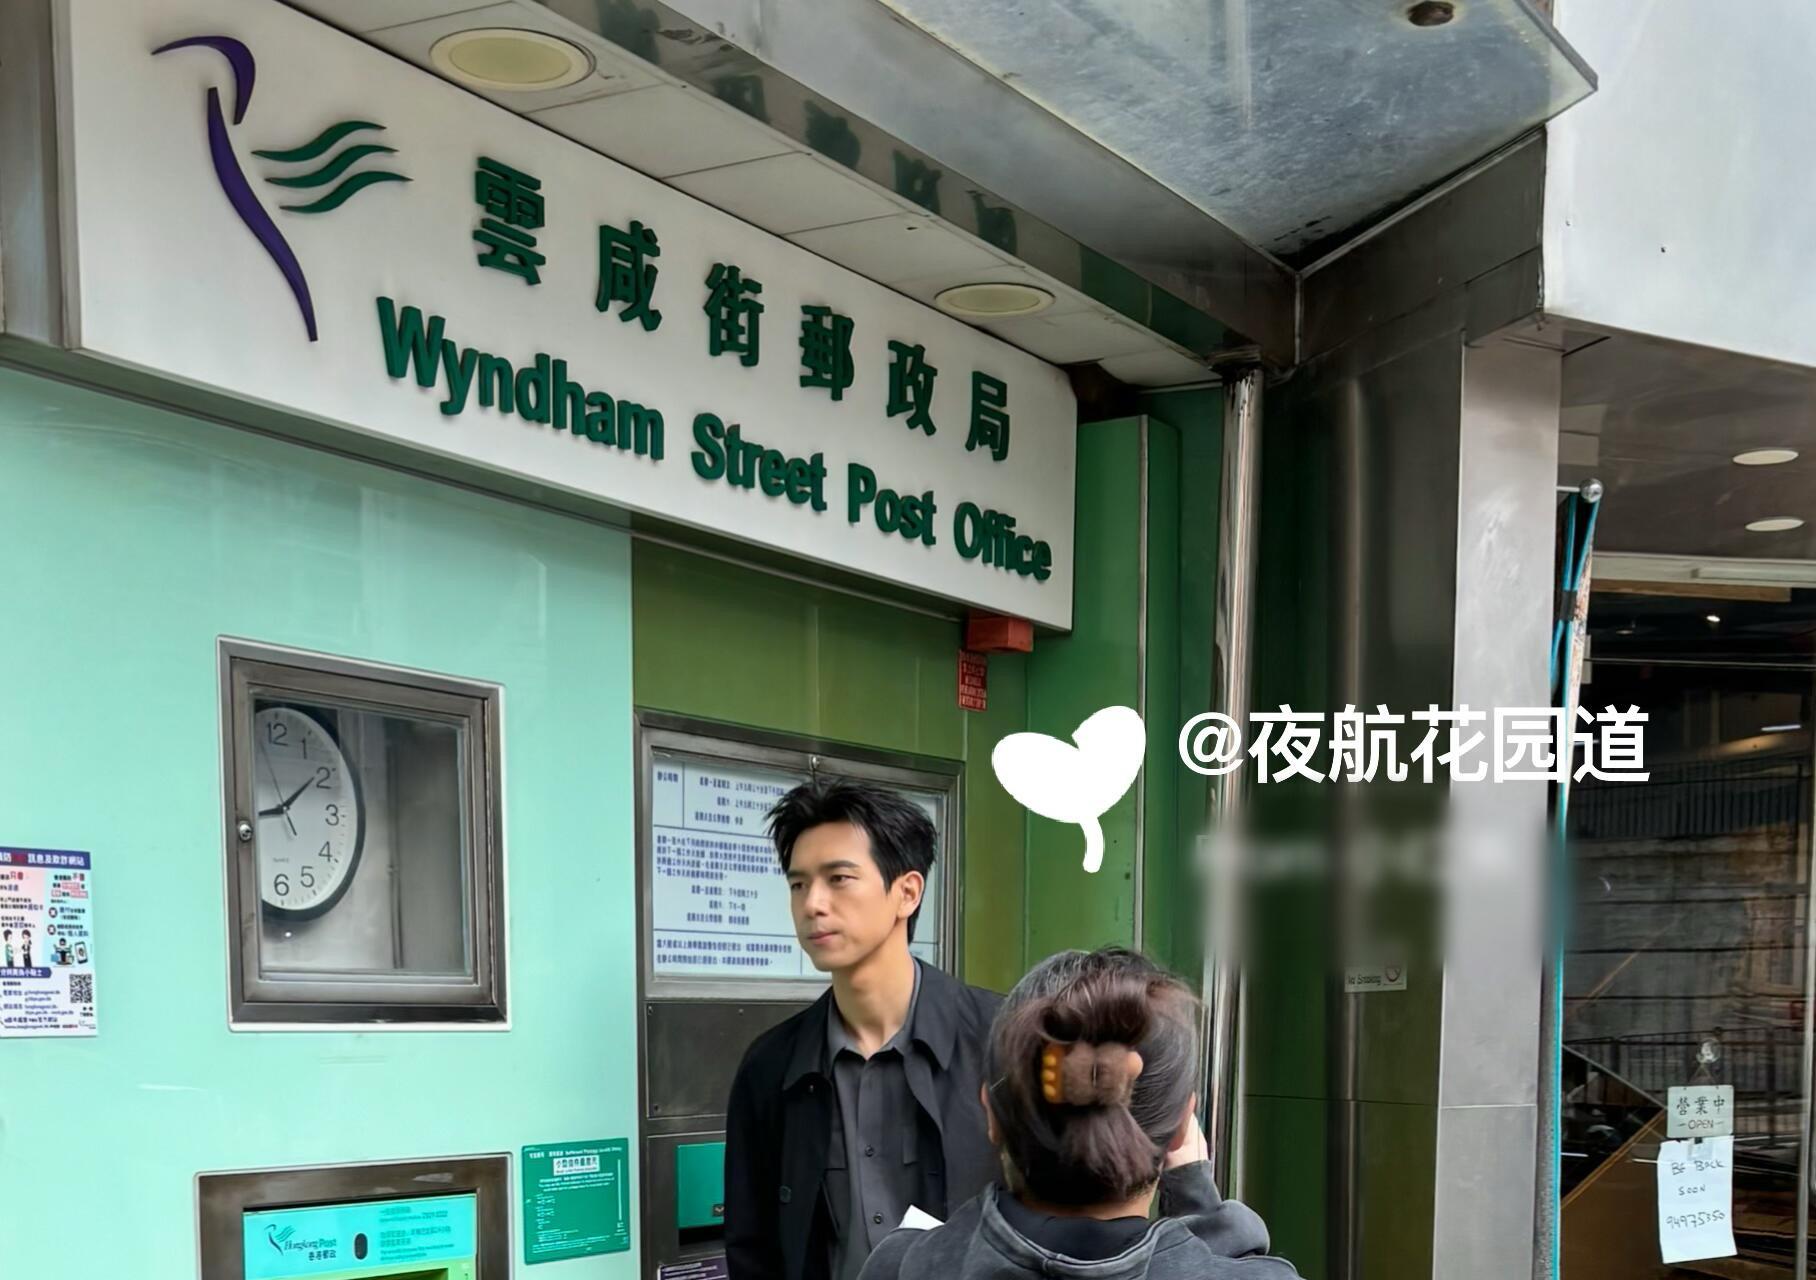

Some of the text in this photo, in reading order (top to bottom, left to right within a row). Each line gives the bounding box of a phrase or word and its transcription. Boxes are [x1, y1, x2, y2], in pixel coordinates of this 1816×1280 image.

[473, 156, 1010, 462] 雲咸街郵政局
[376, 296, 1052, 581] Wyndham Street Post Office
[267, 722, 288, 747] 12
[301, 738, 307, 759] 1
[316, 767, 331, 789] 2
[325, 804, 339, 826] 3
[318, 841, 333, 862] 4
[274, 874, 289, 896] 6
[300, 866, 314, 888] 5
[1676, 1095, 1725, 1116] 營業中
[1688, 1119, 1714, 1130] OPEN
